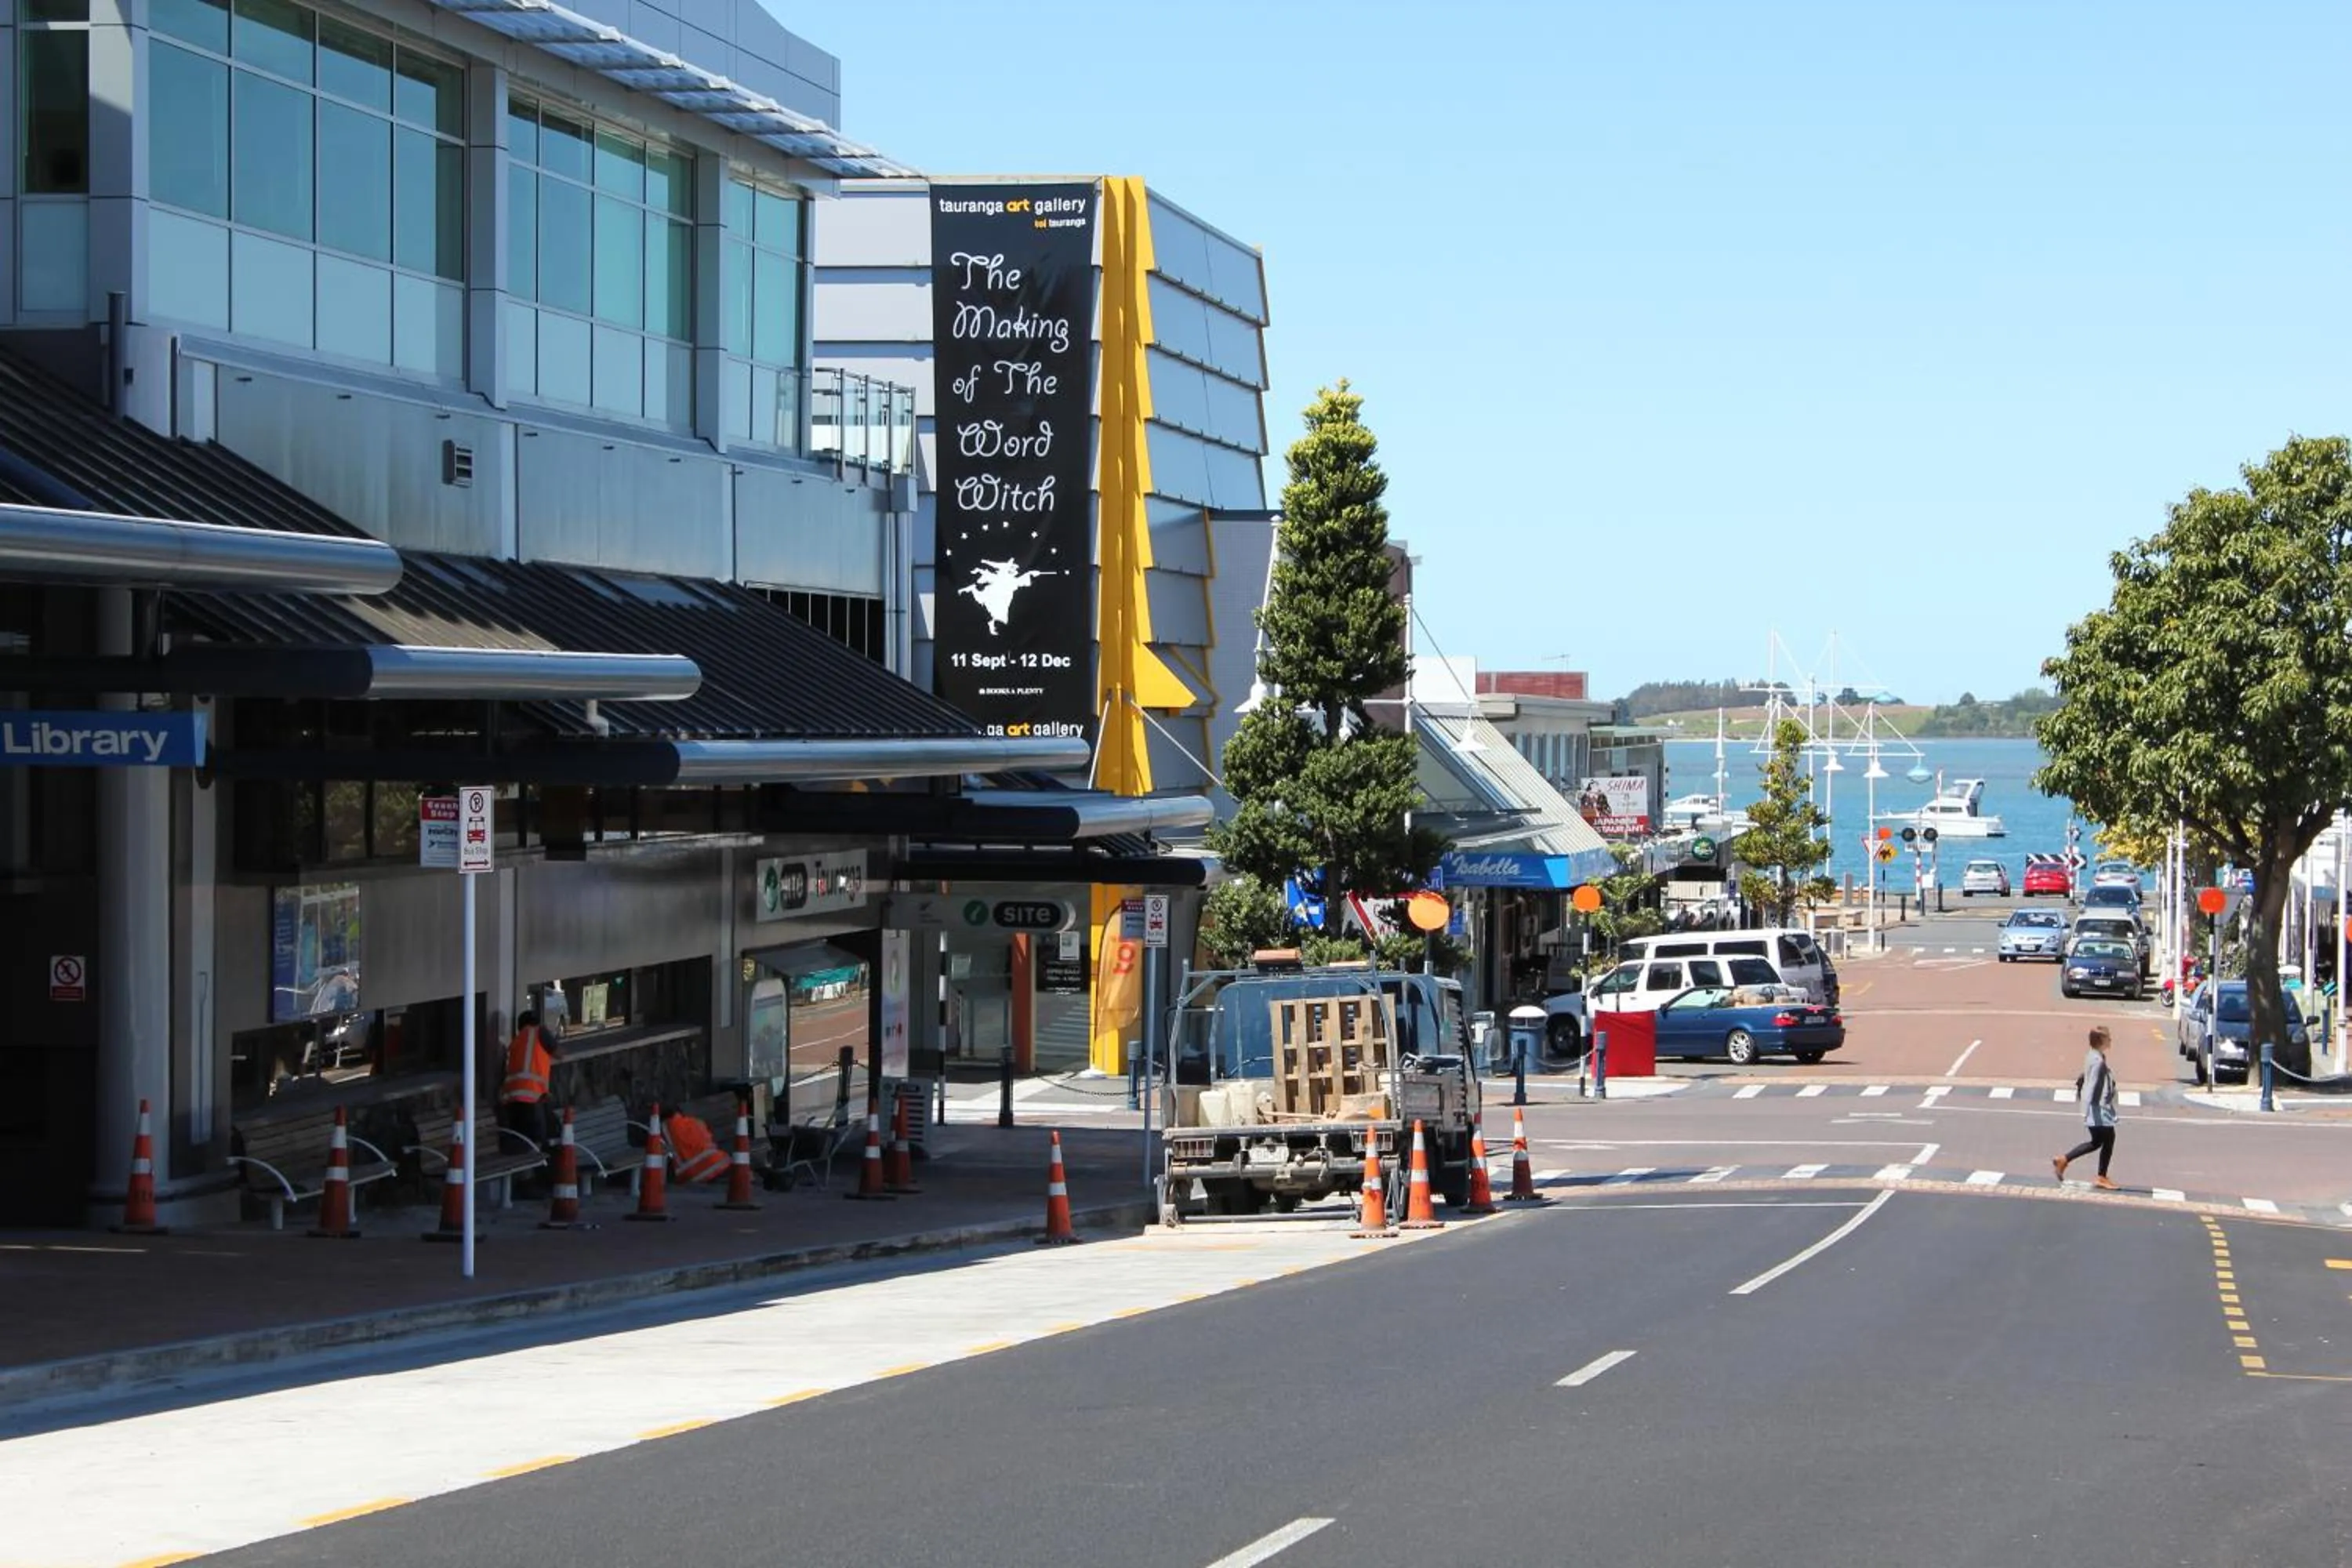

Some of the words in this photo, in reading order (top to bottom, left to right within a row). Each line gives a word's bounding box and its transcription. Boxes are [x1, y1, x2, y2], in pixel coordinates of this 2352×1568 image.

[939, 198, 1004, 216] tauranga
[1006, 198, 1030, 212] art
[1034, 198, 1086, 216] gallery
[1049, 217, 1087, 228] tauranga
[950, 252, 1022, 291] The
[953, 301, 1069, 354] Making
[953, 365, 982, 404] of
[993, 360, 1058, 395] The
[956, 419, 1054, 458] Word
[955, 474, 1057, 512] Witch
[951, 654, 967, 666] 11
[971, 654, 1005, 670] Sept
[1020, 654, 1037, 666] 12
[1042, 654, 1071, 667] Dec
[1007, 722, 1030, 736] art
[1033, 720, 1083, 738] gallery
[3, 720, 168, 762] Library
[1607, 779, 1645, 792] SHIMA
[426, 800, 459, 810] Coach
[430, 810, 456, 818] Stop
[1451, 855, 1521, 876] Isabella
